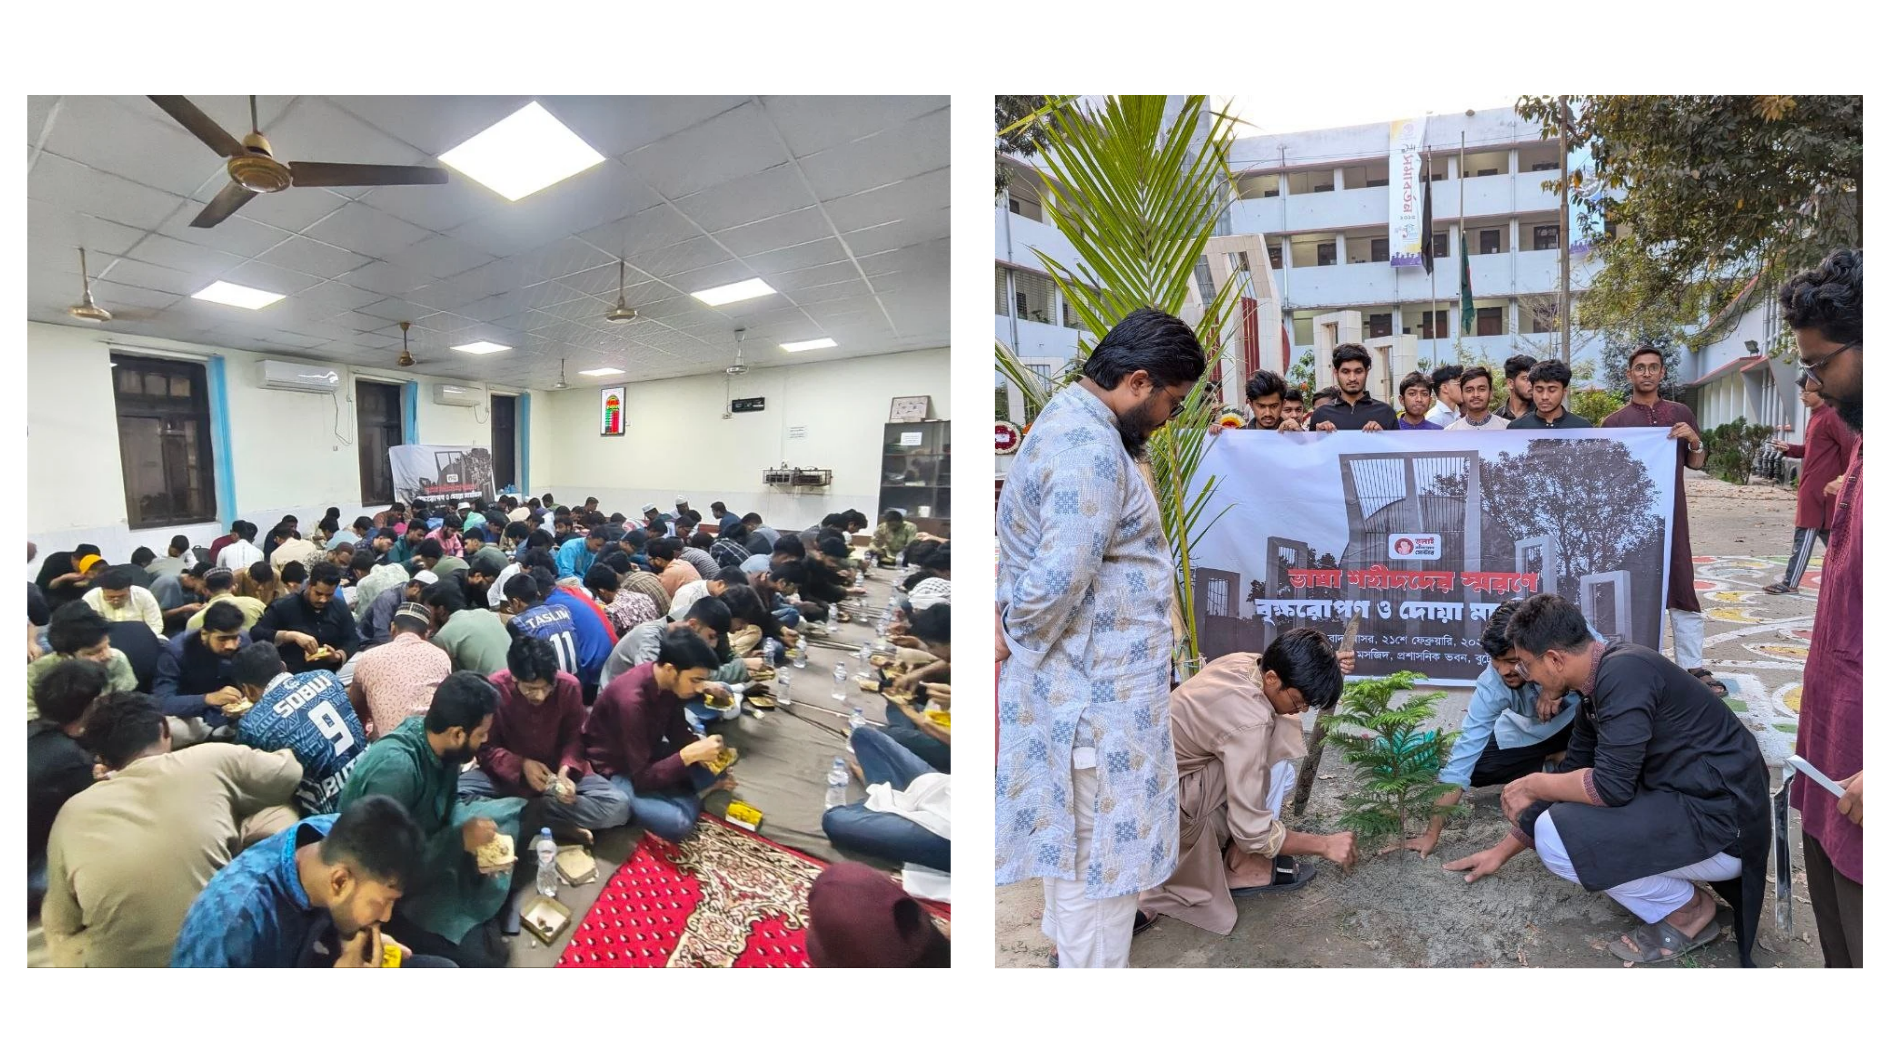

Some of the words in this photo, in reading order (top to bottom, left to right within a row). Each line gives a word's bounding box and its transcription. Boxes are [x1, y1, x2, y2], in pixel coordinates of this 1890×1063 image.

[1287, 569, 1342, 589] ভাষা
[1347, 564, 1455, 594] শহীদদের
[1461, 570, 1540, 595] স্মরণে
[525, 609, 571, 629] TASLIM
[1254, 598, 1371, 626] বৃক্ষরোপণ
[1377, 600, 1392, 619] ও
[1400, 601, 1464, 623] দোয়া
[549, 630, 578, 675] 11
[1382, 635, 1408, 645] ২১শে
[1411, 634, 1457, 647] ফেব্রুয়ারি,
[1356, 648, 1393, 661] মসজিদ,
[1397, 650, 1441, 662] প্রশাসনিক
[1444, 652, 1471, 663] ভবন,
[307, 700, 354, 757] 9
